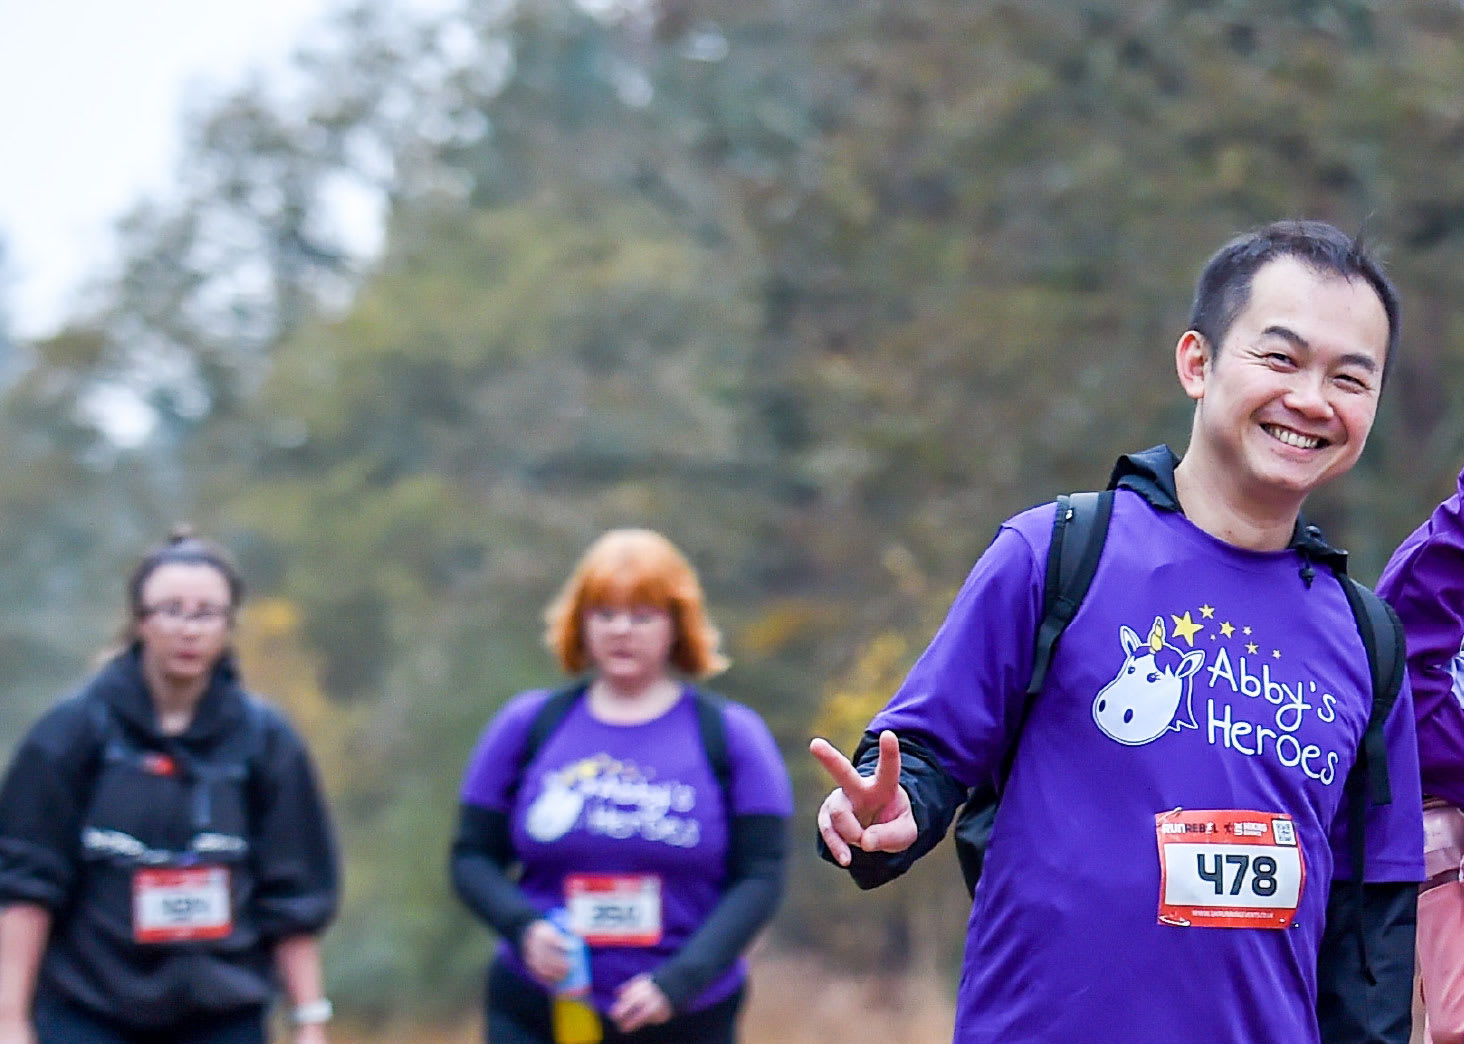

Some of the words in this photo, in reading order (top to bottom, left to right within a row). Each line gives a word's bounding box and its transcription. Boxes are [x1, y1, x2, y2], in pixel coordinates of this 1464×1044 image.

[1207, 647, 1337, 732] Abby's
[1207, 699, 1339, 785] Heroes
[1196, 853, 1278, 898] 478
